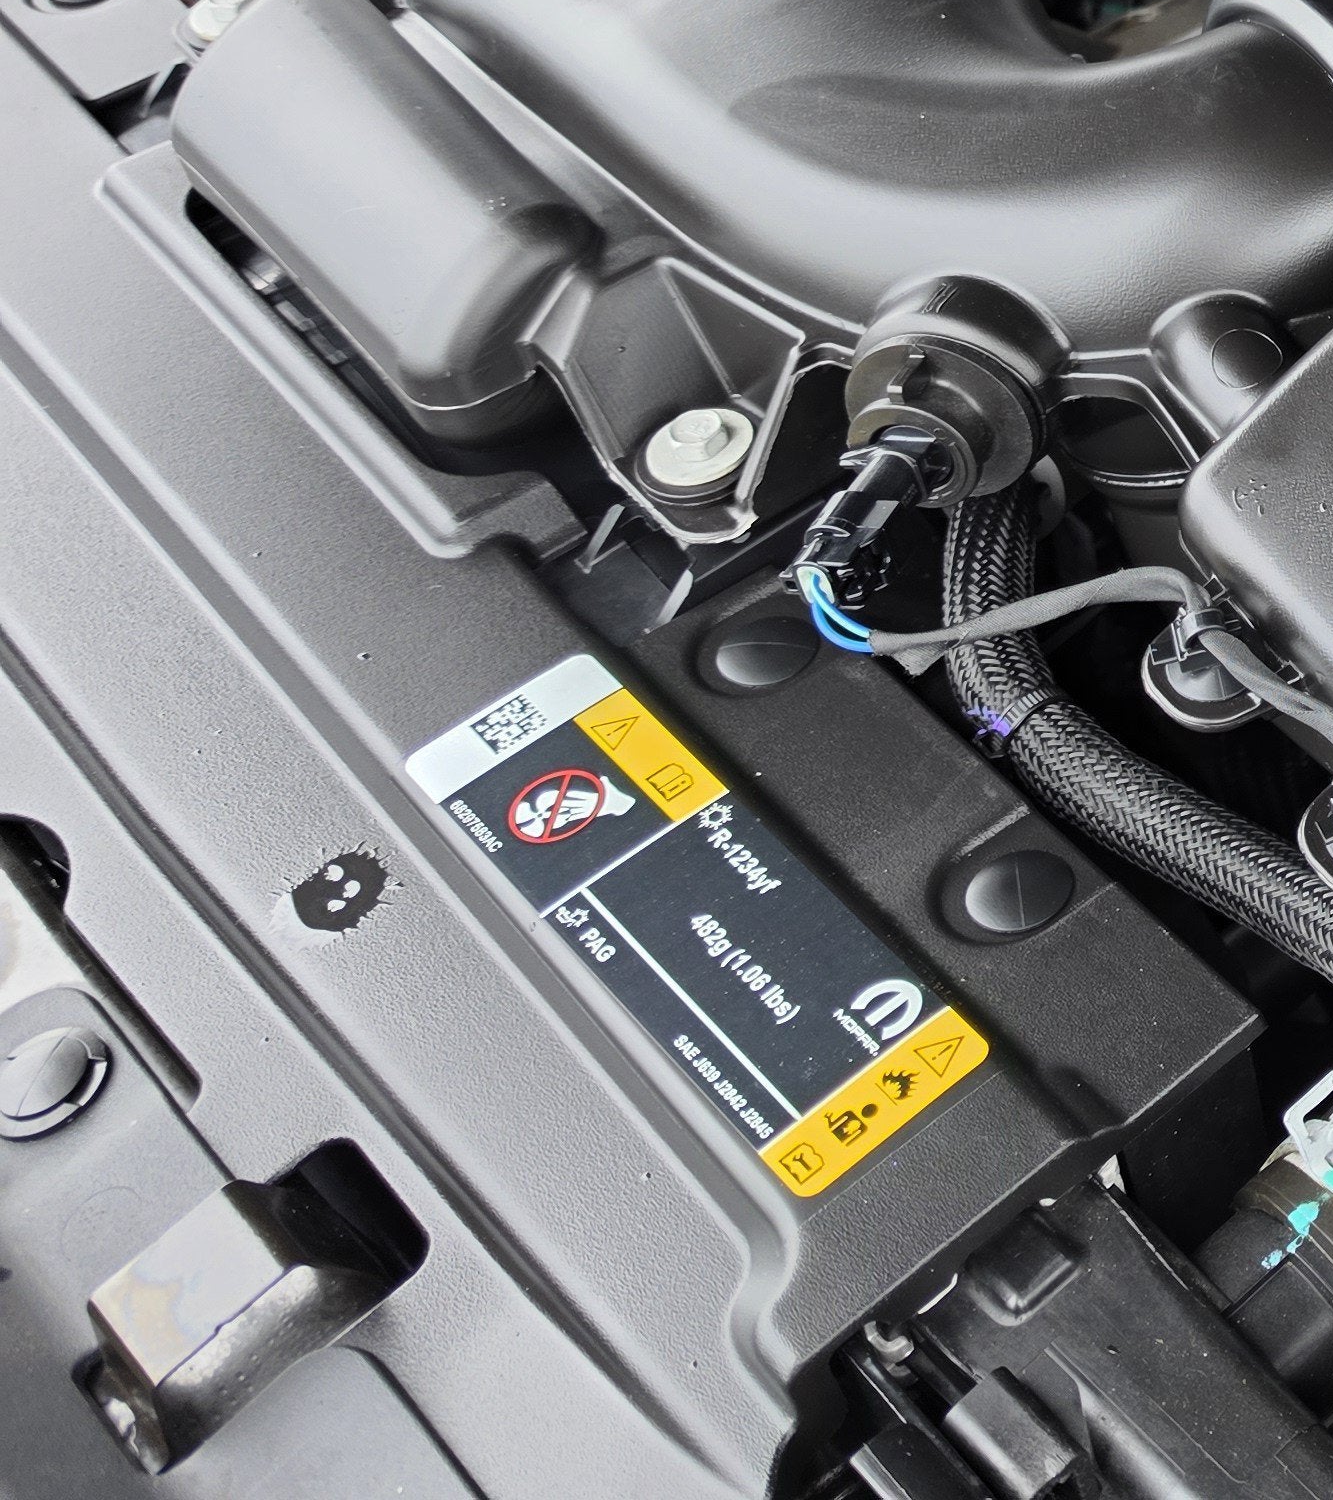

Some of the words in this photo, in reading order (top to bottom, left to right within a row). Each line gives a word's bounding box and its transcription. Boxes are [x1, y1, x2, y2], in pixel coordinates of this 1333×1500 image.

[707, 828, 782, 894] R-1234yf
[578, 927, 616, 962] PAG
[691, 914, 732, 957] 482g
[721, 949, 771, 991] (1.06
[761, 984, 801, 1024] lbs)
[673, 1035, 701, 1061] SAE
[693, 1057, 722, 1083] J639
[713, 1080, 748, 1112] J2842
[740, 1108, 774, 1139] J2845
